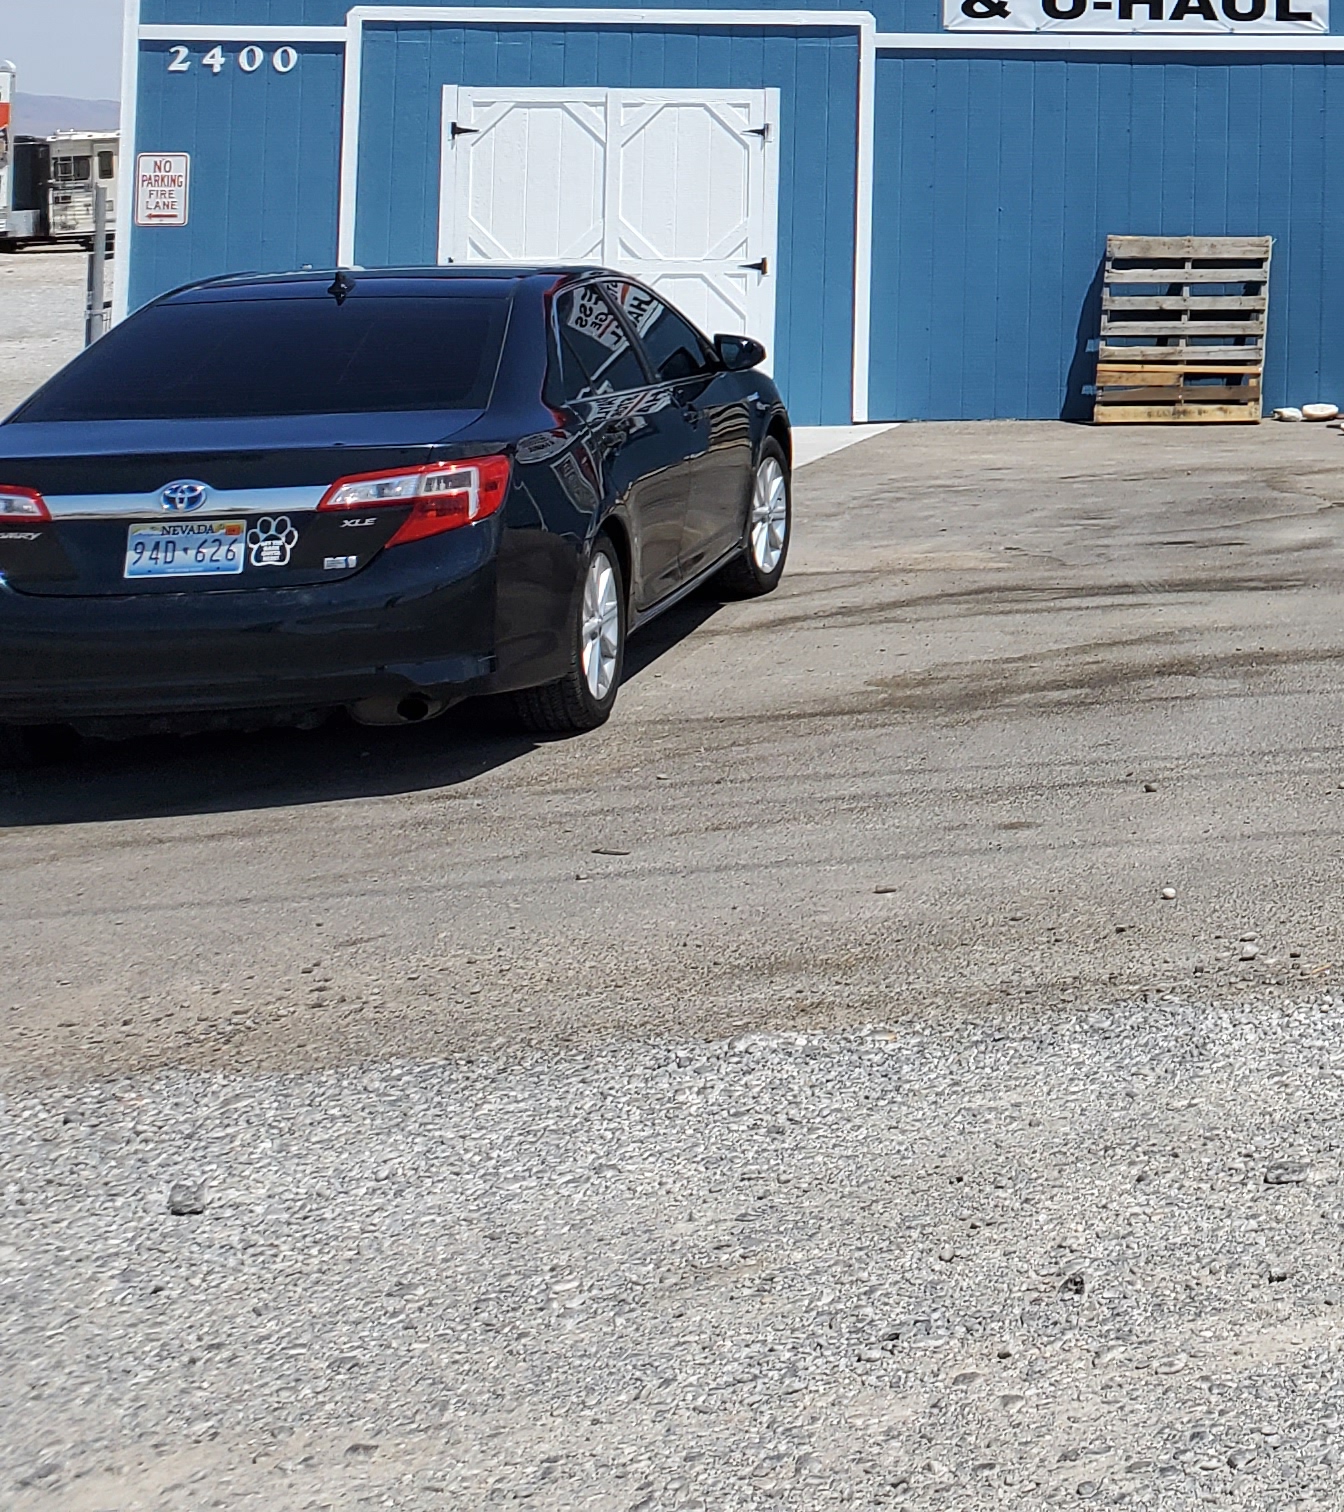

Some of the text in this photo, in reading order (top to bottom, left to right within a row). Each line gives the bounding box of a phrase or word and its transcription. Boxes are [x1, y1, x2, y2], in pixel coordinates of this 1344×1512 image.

[167, 45, 298, 73] 2400
[153, 160, 172, 173] NO
[141, 174, 183, 188] PARKING
[149, 190, 175, 199] FIRE
[146, 200, 178, 210] LANE
[339, 518, 377, 528] XLE
[161, 524, 215, 536] NEVADA
